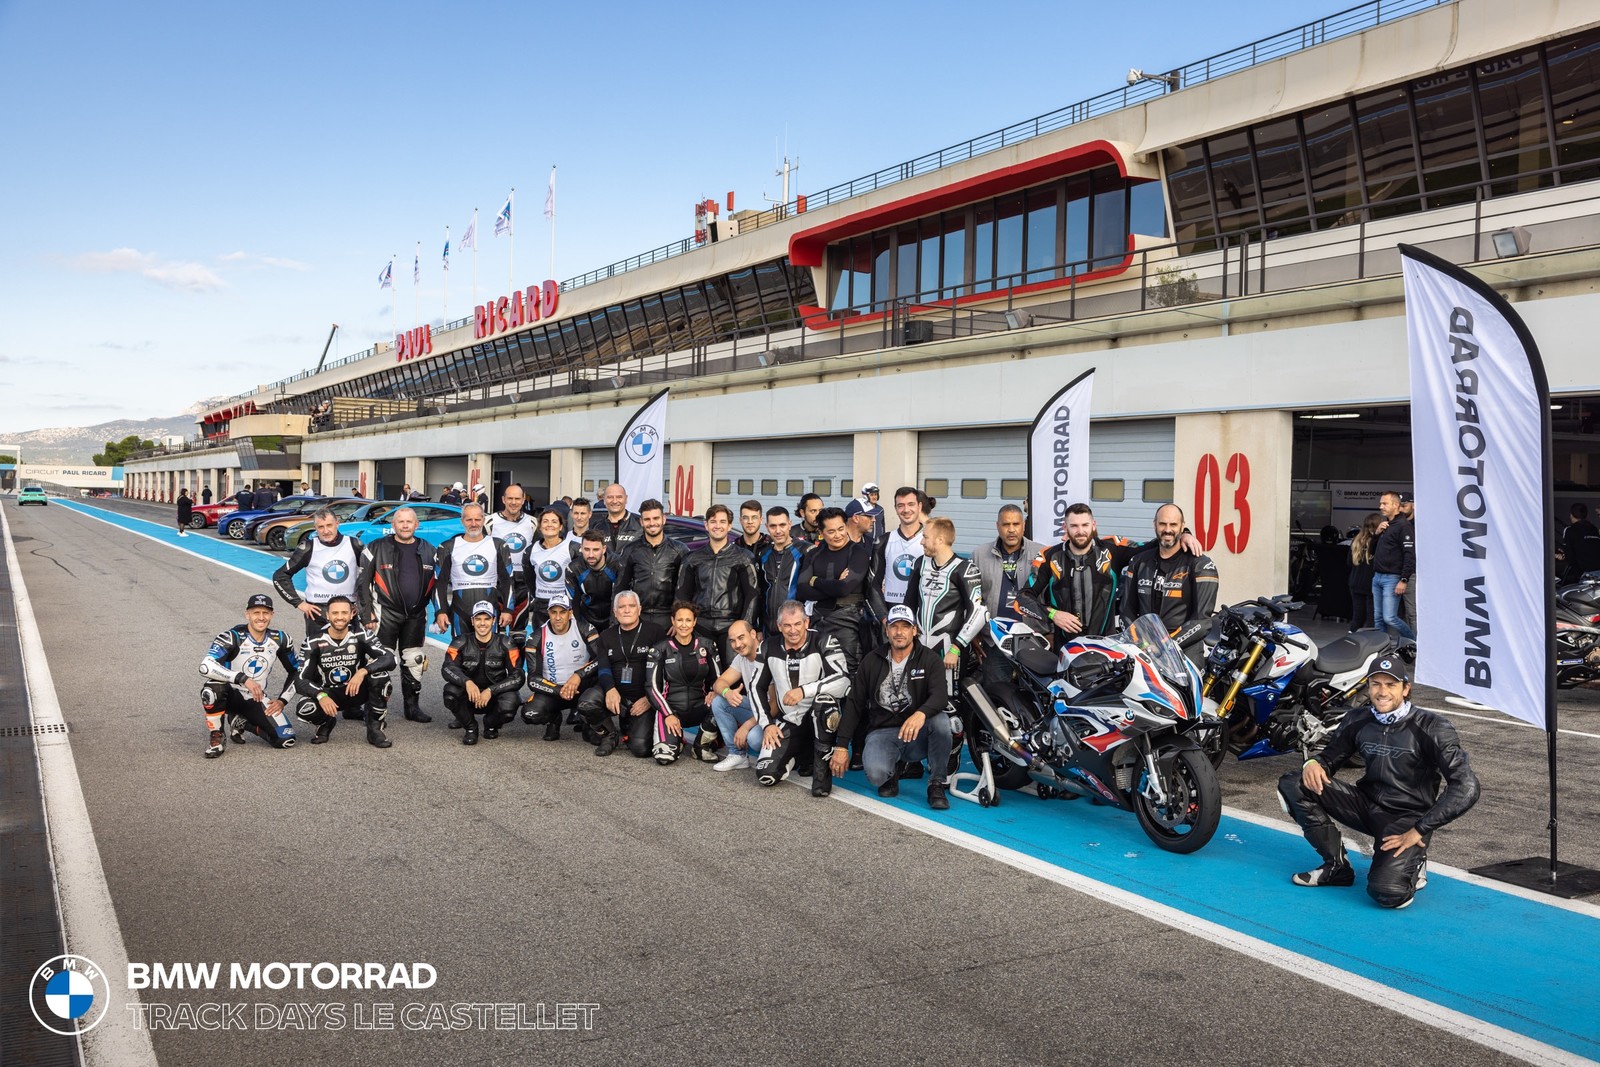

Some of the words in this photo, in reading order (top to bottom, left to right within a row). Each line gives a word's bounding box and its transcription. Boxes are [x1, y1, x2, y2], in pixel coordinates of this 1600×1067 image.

[396, 324, 433, 363] PAUL
[474, 280, 559, 339] RICARD
[675, 464, 694, 517] 04
[1053, 405, 1071, 538] MOTORRAD
[1194, 452, 1251, 554] 03
[320, 655, 342, 663] MOTO
[342, 653, 358, 661] RIDE
[321, 660, 356, 668] TOULOUSE
[545, 640, 558, 684] RACKDAYS
[1360, 741, 1415, 759] RST
